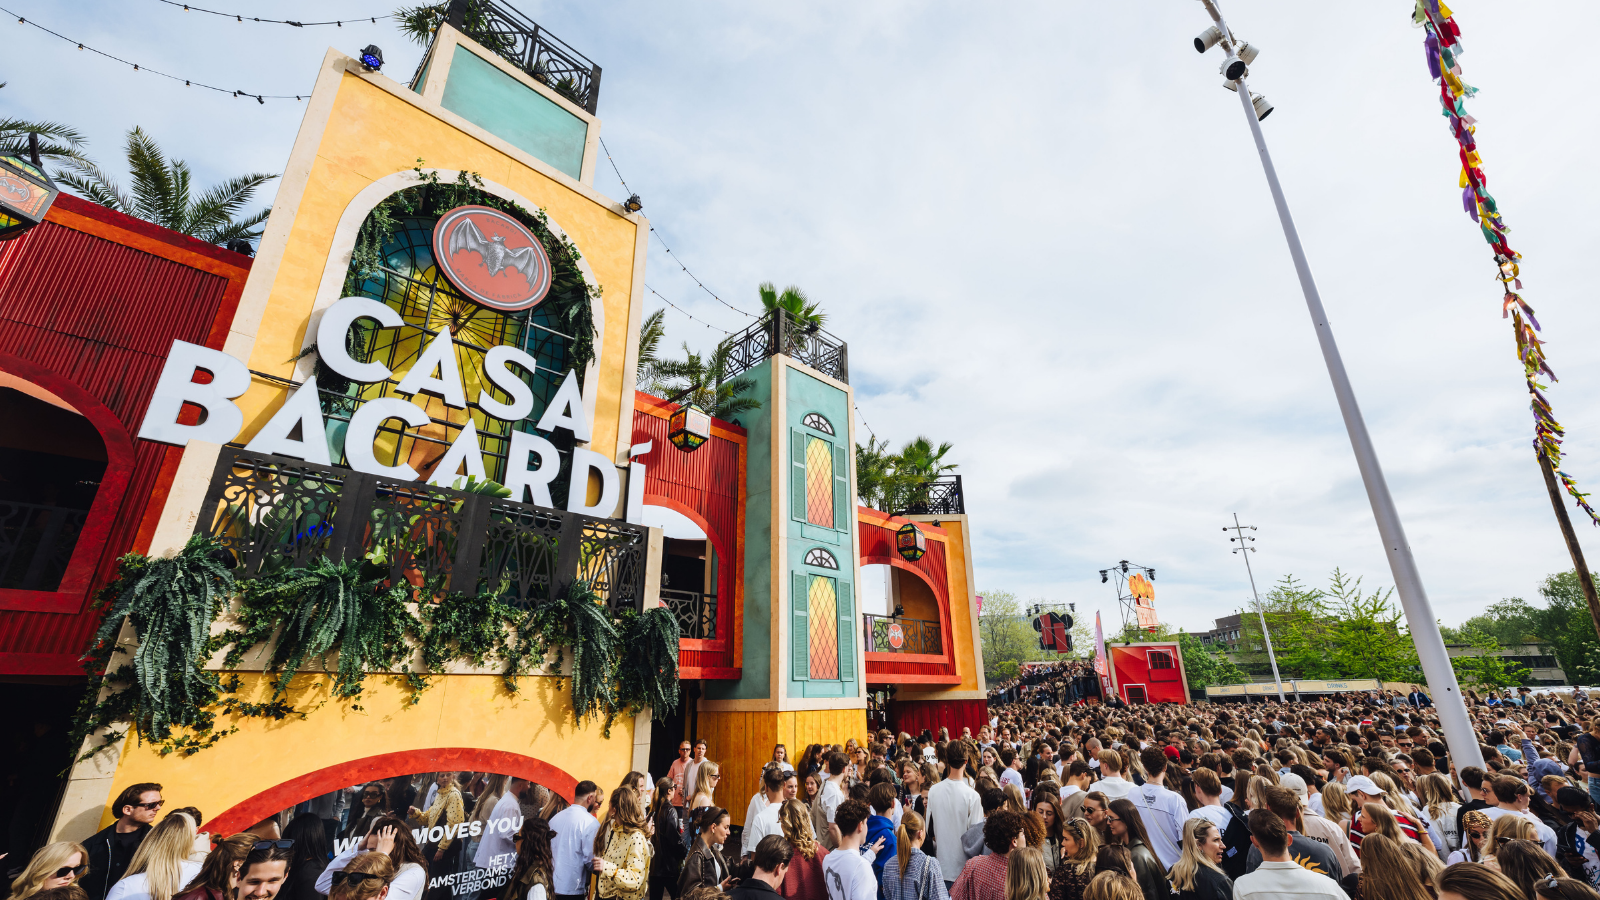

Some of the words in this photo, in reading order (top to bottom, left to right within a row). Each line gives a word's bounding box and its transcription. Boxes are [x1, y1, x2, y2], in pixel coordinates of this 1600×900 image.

[456, 268, 477, 289] MARCA
[316, 296, 592, 443] CASA
[137, 338, 653, 525] BACARDÍ
[411, 820, 482, 845] MOVES
[487, 815, 525, 835] YOU
[489, 853, 510, 867] HET
[428, 864, 508, 890] AMSTERDAMS
[451, 875, 507, 896] VERBOND
